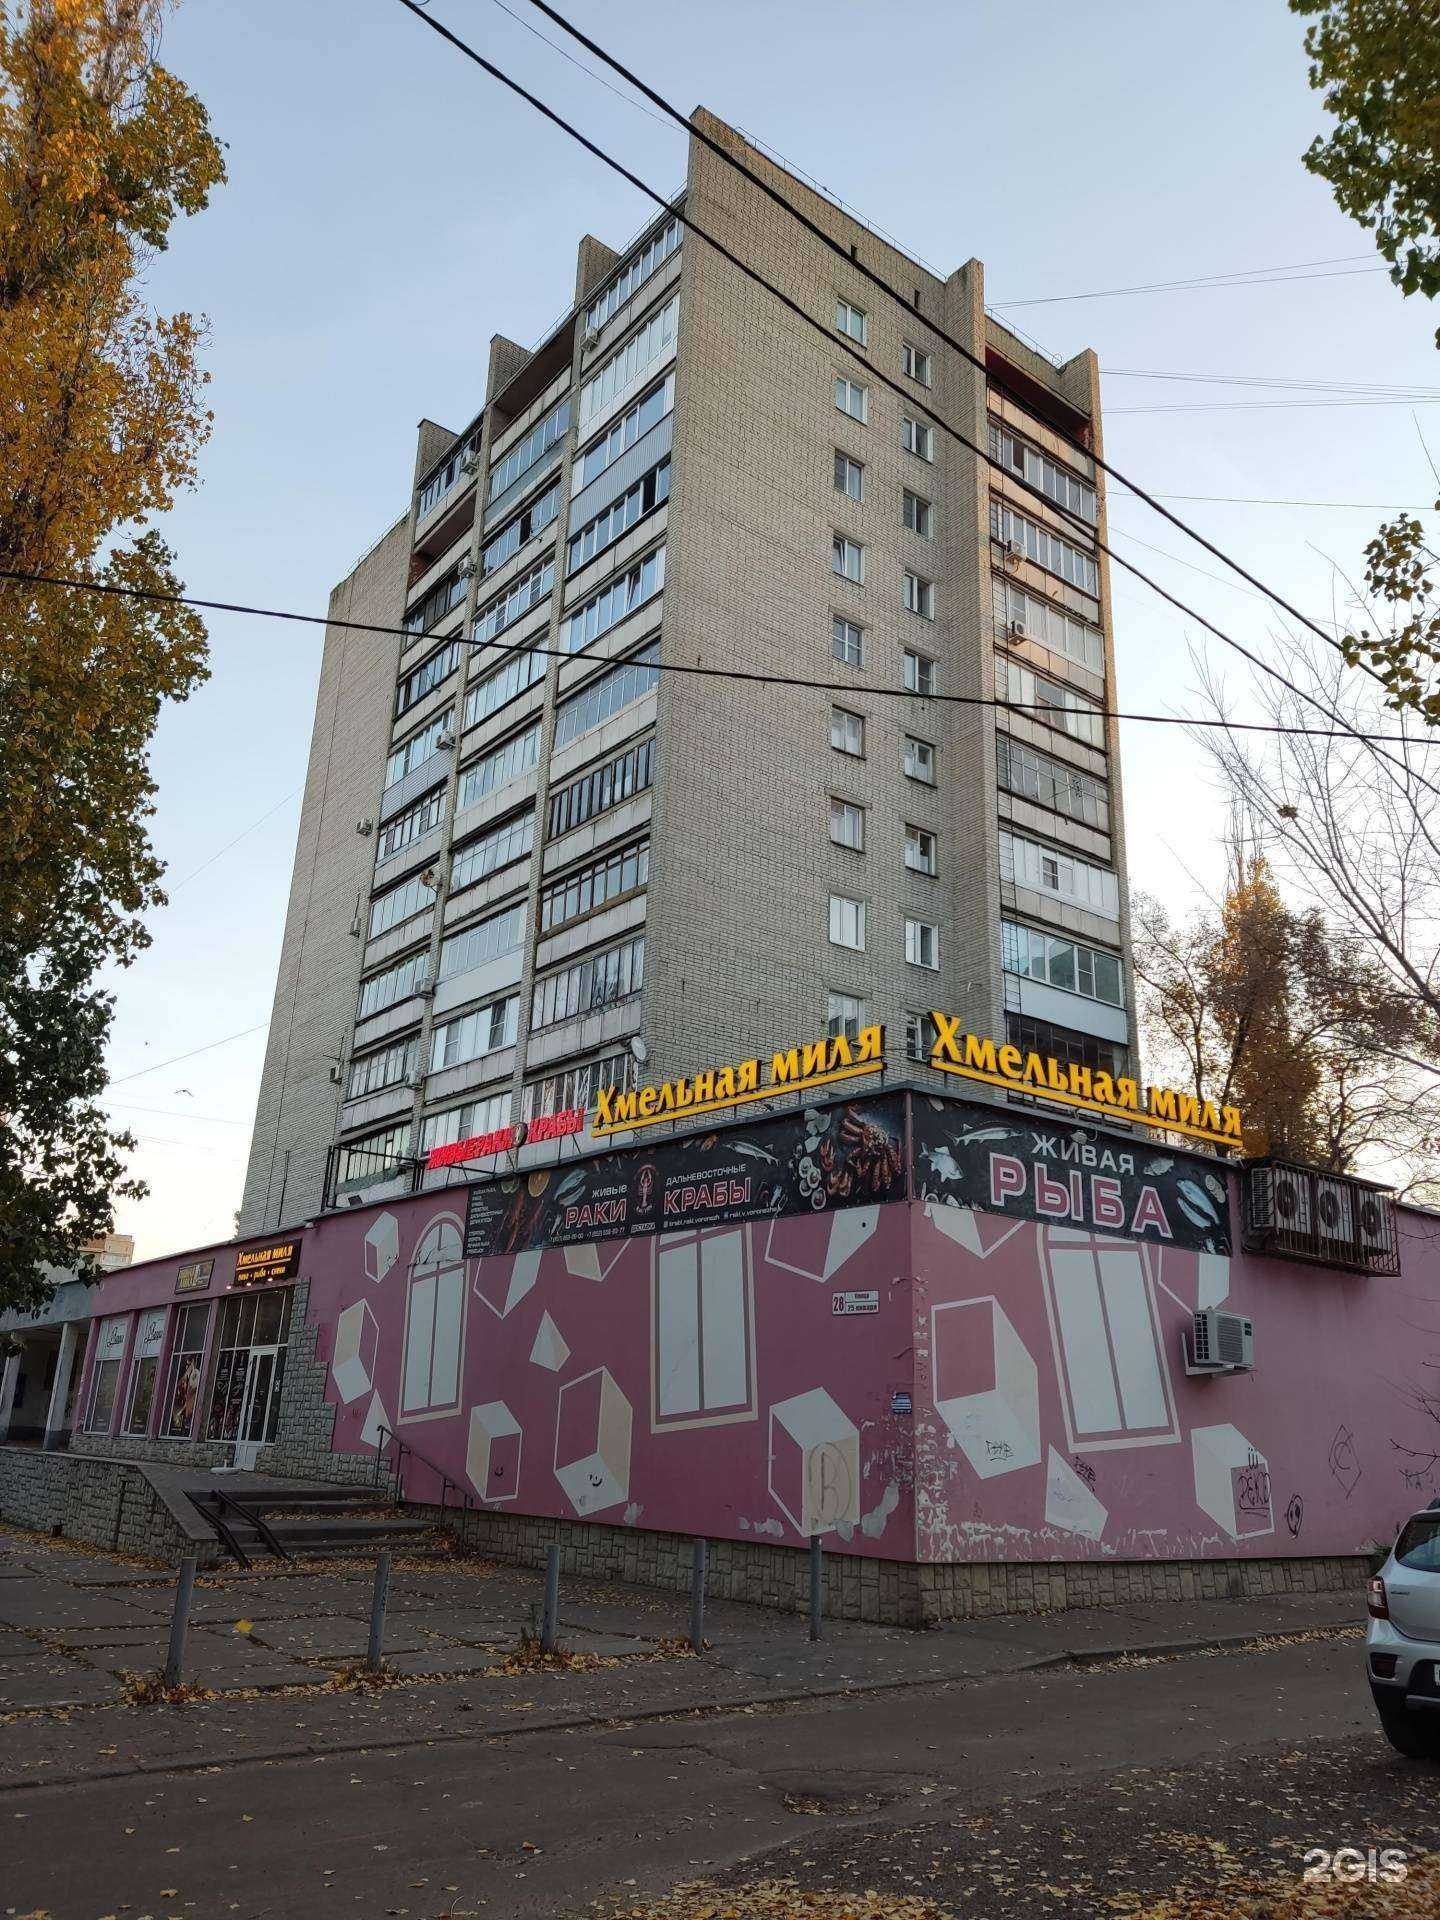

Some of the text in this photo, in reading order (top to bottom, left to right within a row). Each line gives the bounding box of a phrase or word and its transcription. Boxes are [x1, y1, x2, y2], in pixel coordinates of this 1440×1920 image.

[592, 1024, 886, 1127] Хмельная миля
[928, 1010, 1242, 1137] Хмельная миля
[528, 1106, 586, 1143] КРАБЫ
[1031, 1131, 1135, 1177] ЖИВАЯ
[666, 1163, 747, 1187] ДАЛЬНЕВОСТОЧНЫЕ
[565, 1198, 627, 1230] РАКИ
[663, 1177, 751, 1215] КРАБЫ
[989, 1151, 1174, 1239] РЫБА
[833, 1296, 844, 1312] 28
